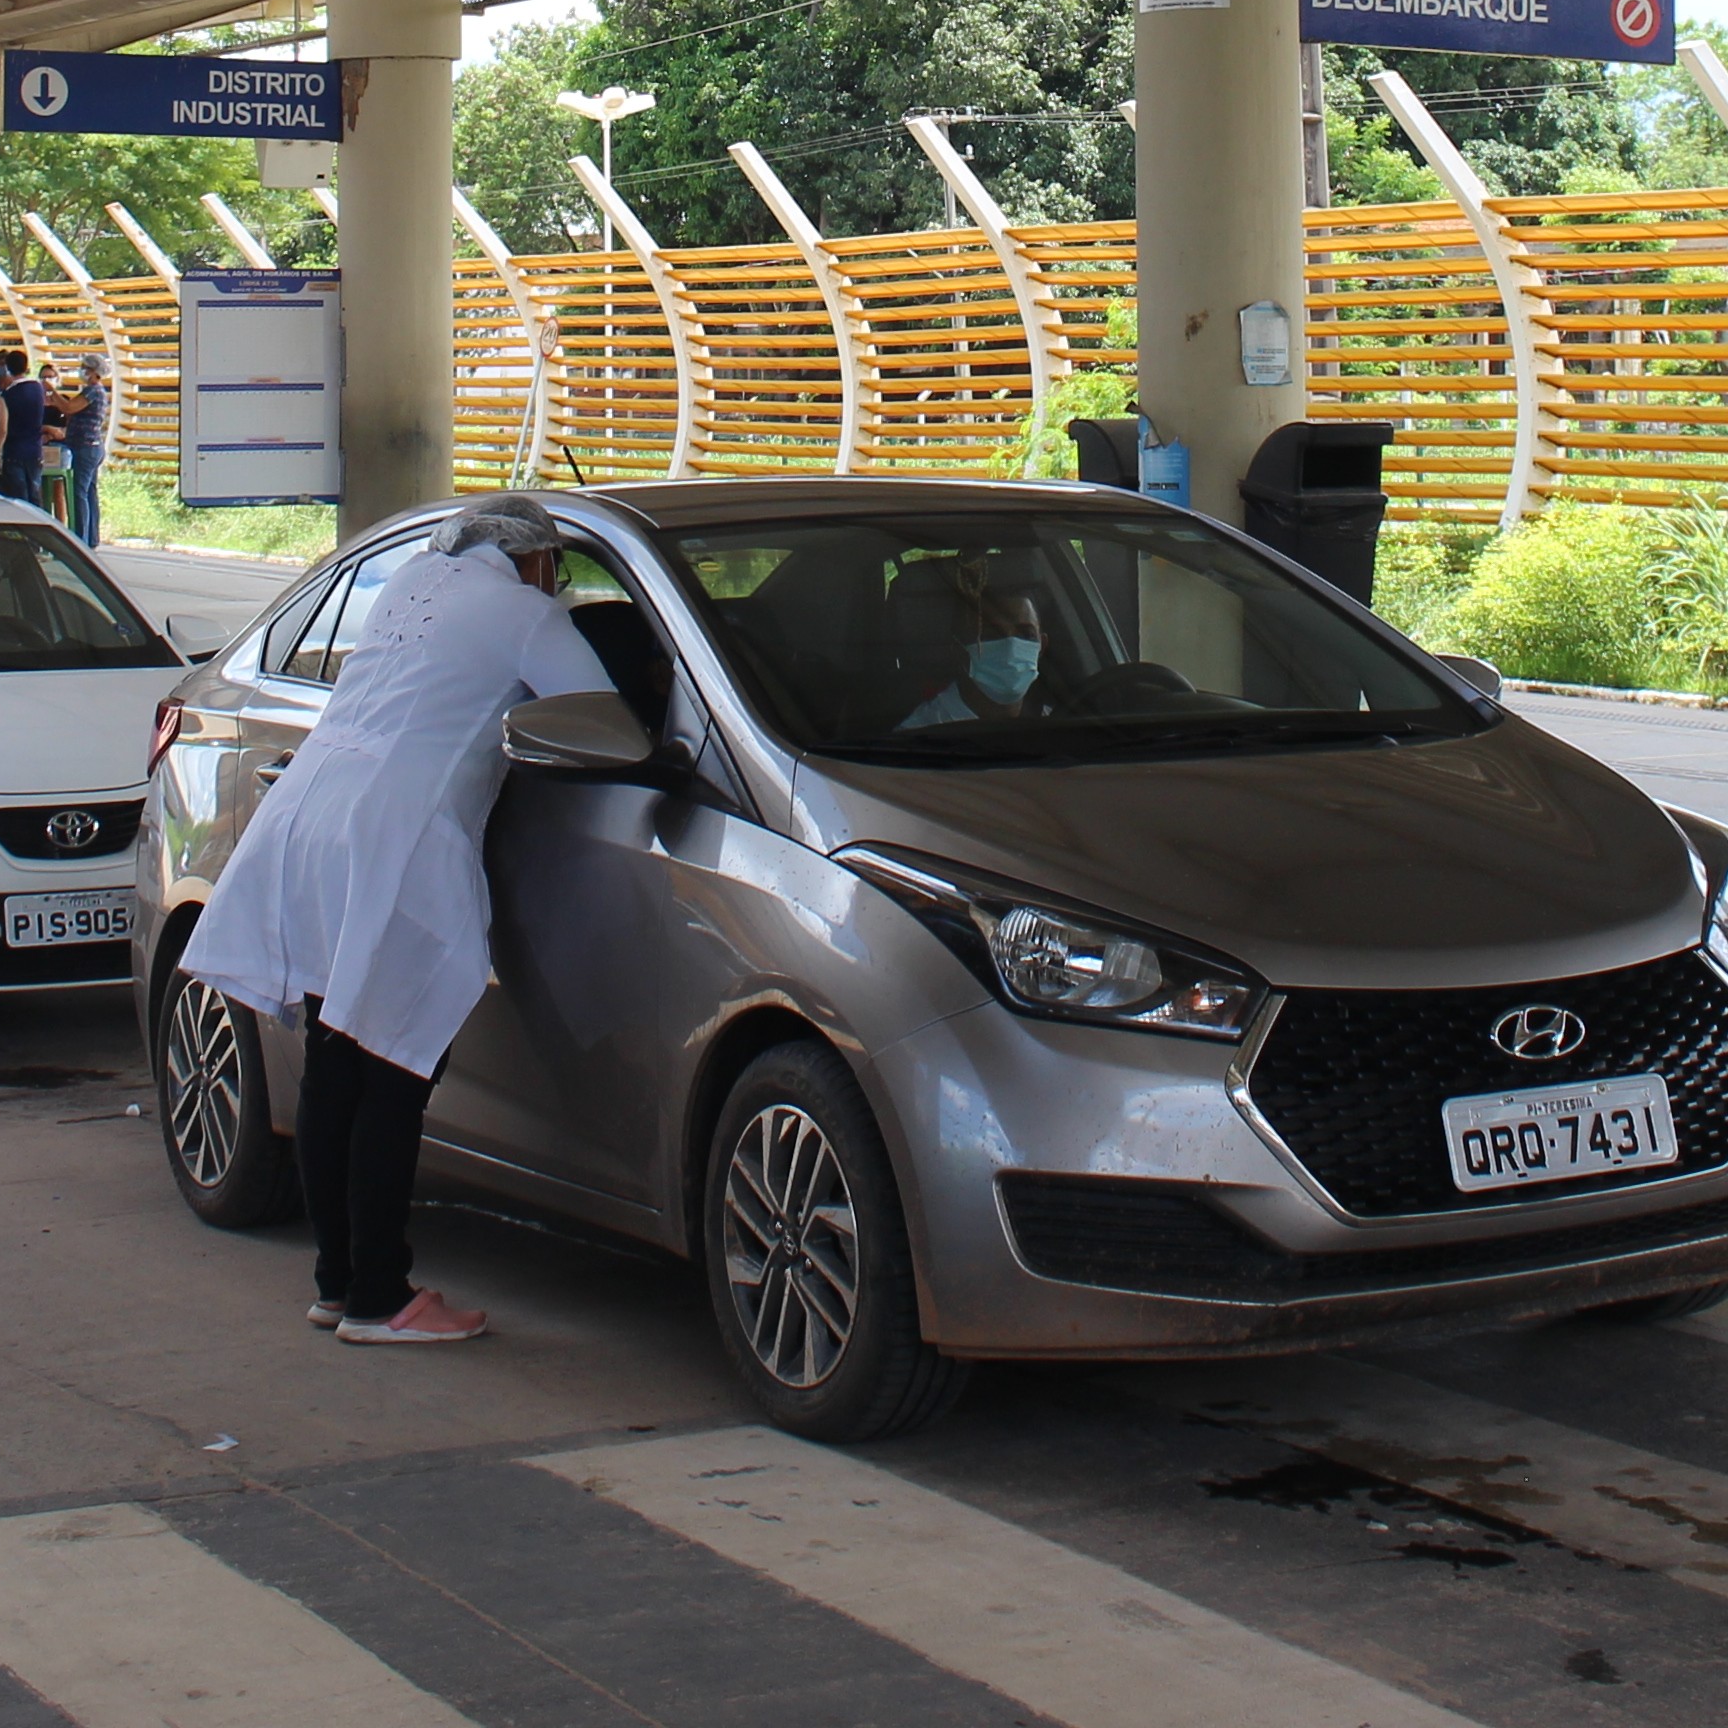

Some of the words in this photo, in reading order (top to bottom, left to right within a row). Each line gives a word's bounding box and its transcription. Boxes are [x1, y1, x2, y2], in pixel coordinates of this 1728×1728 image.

[208, 70, 325, 97] DISTRITO
[172, 100, 326, 128] INDUSTRIAL
[543, 325, 557, 344] 20
[13, 907, 135, 941] PIS-905
